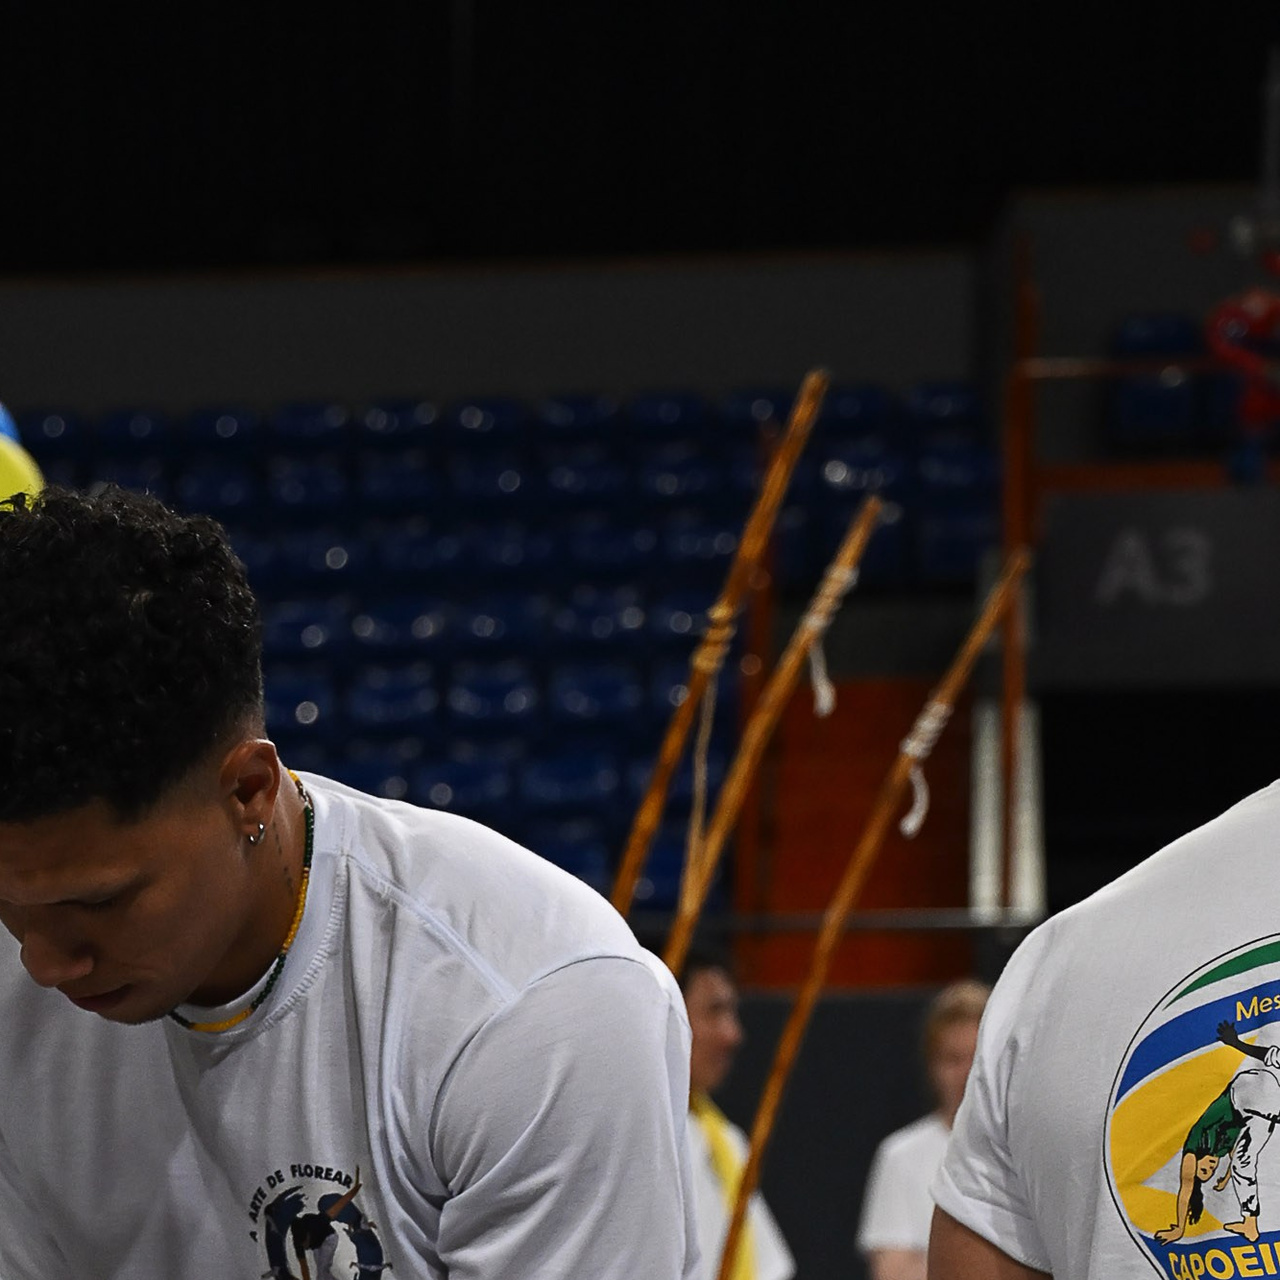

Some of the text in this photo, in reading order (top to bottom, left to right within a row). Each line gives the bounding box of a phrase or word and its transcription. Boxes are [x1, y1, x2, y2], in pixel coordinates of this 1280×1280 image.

[1094, 531, 1213, 603] A3
[249, 1164, 353, 1242] A ARTE DE FLOREAR
